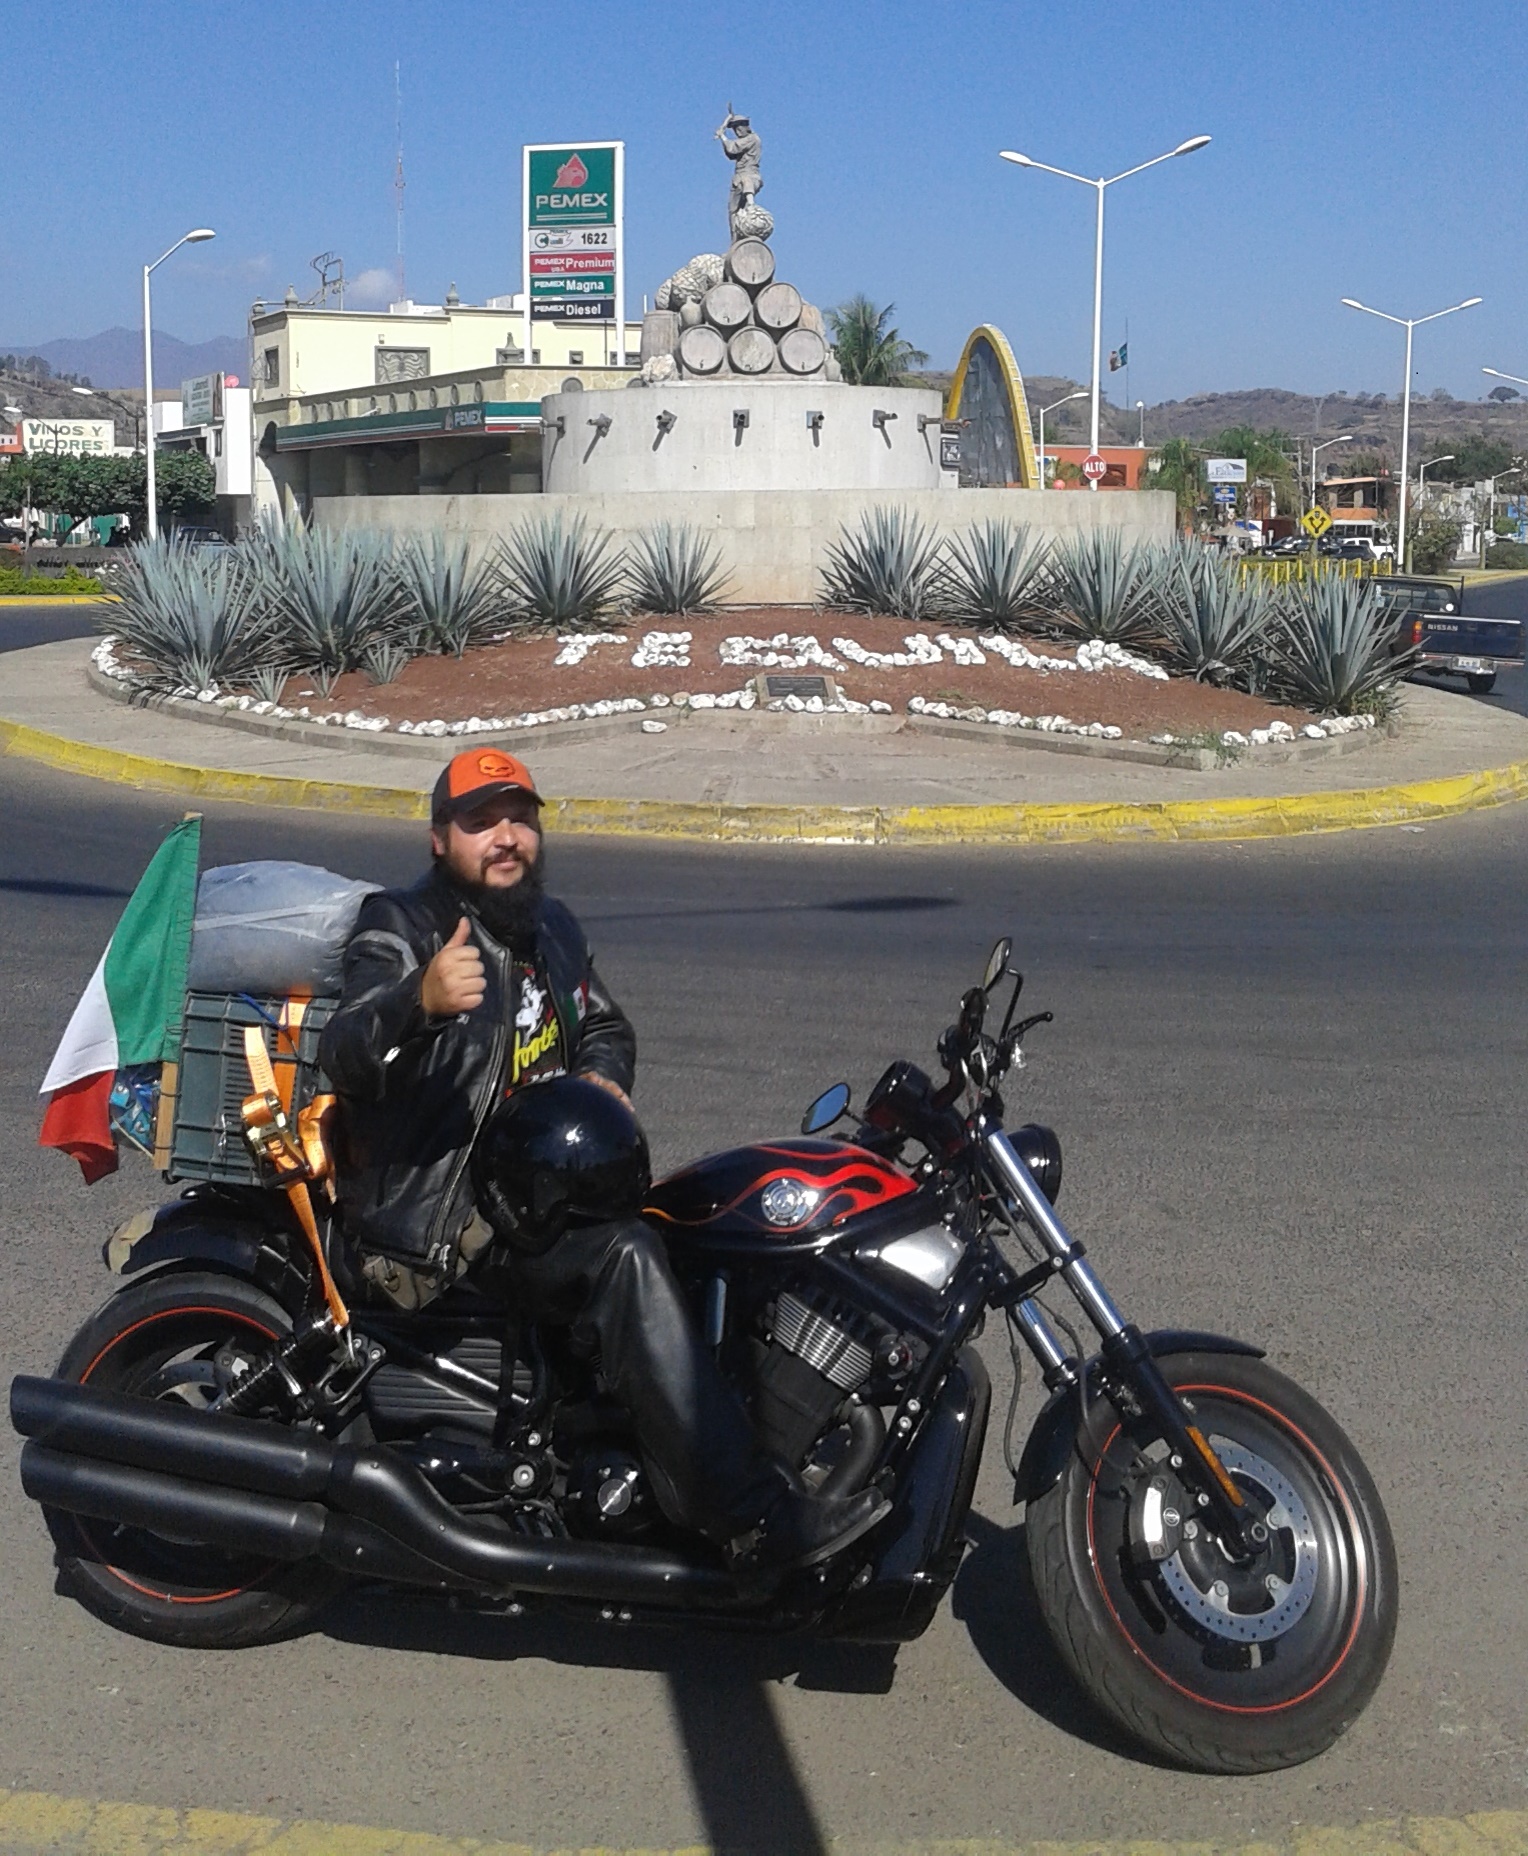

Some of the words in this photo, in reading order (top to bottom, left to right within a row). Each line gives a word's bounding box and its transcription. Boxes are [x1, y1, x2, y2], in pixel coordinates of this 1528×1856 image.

[535, 192, 608, 209] PEMEX
[581, 232, 608, 245] 1622
[534, 258, 565, 266] PEMEX
[566, 257, 614, 269] Premium
[534, 280, 565, 288] PEMEX
[566, 279, 605, 293] Magna
[566, 303, 602, 316] Diesel
[454, 409, 483, 427] PEMEX
[92, 425, 103, 437] Y
[29, 437, 103, 451] LICORES
[1085, 461, 1105, 473] ALTO
[1427, 623, 1458, 632] NISSAN
